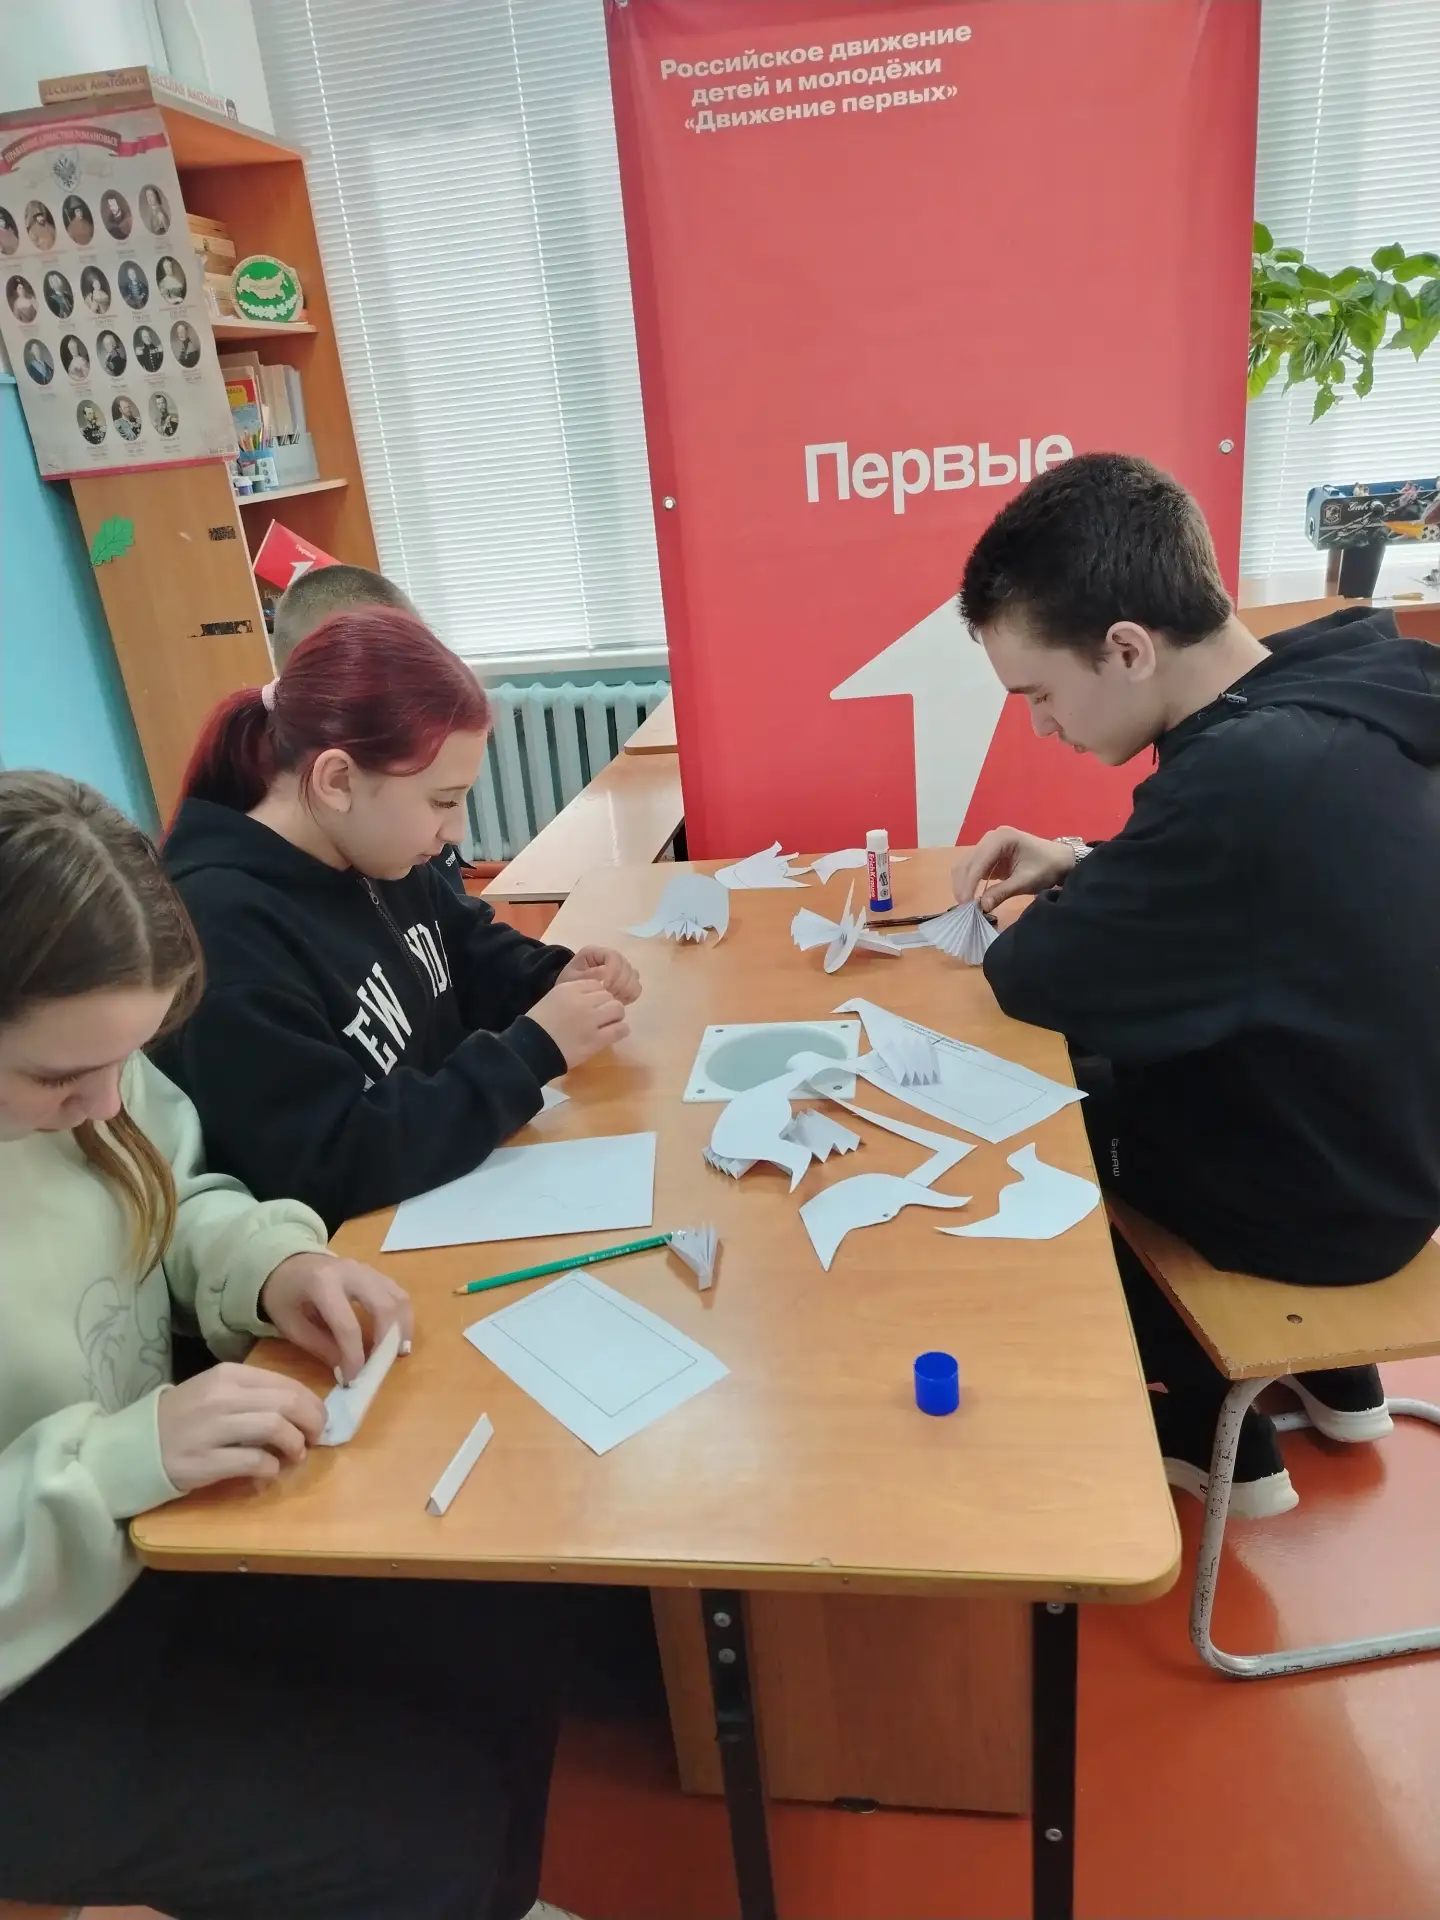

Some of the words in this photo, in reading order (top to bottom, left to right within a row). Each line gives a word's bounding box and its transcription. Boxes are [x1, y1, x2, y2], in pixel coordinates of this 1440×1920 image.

[660, 46, 825, 81] Российское
[828, 24, 973, 62] движение
[684, 99, 836, 134] «Движение
[841, 84, 959, 114] первых»
[691, 76, 770, 108] детей
[775, 78, 793, 94] и
[797, 58, 942, 91] молодёжи
[804, 434, 1074, 515] Первые
[342, 961, 413, 1092] EW
